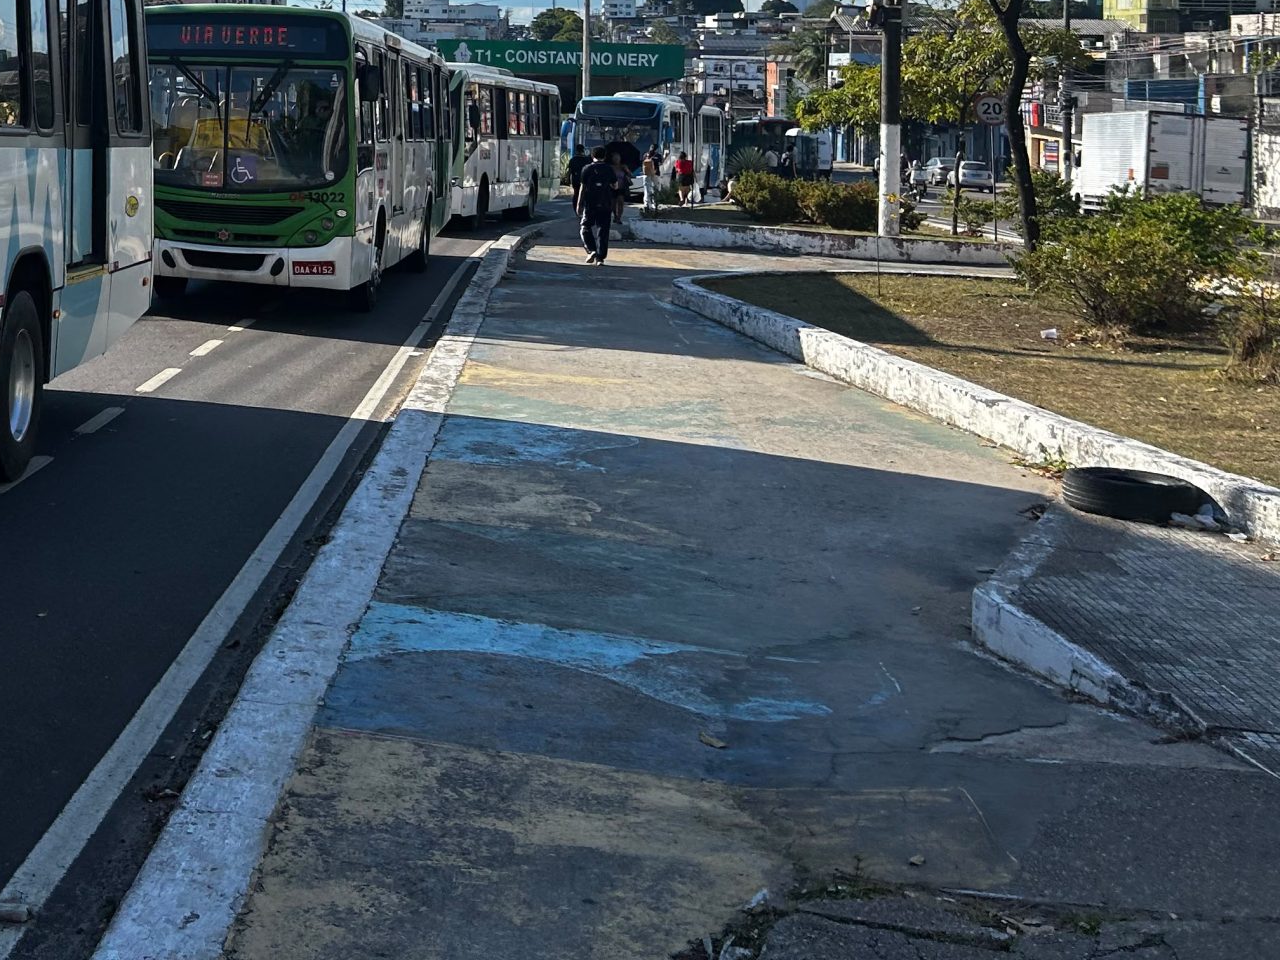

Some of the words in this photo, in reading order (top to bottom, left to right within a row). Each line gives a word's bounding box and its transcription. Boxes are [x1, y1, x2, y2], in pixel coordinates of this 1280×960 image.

[180, 25, 214, 45] VIA
[222, 25, 288, 46] VERDE
[475, 49, 492, 63] T1
[504, 49, 613, 66] CONSTANTNO
[617, 53, 659, 67] NERY
[981, 102, 1002, 115] 20
